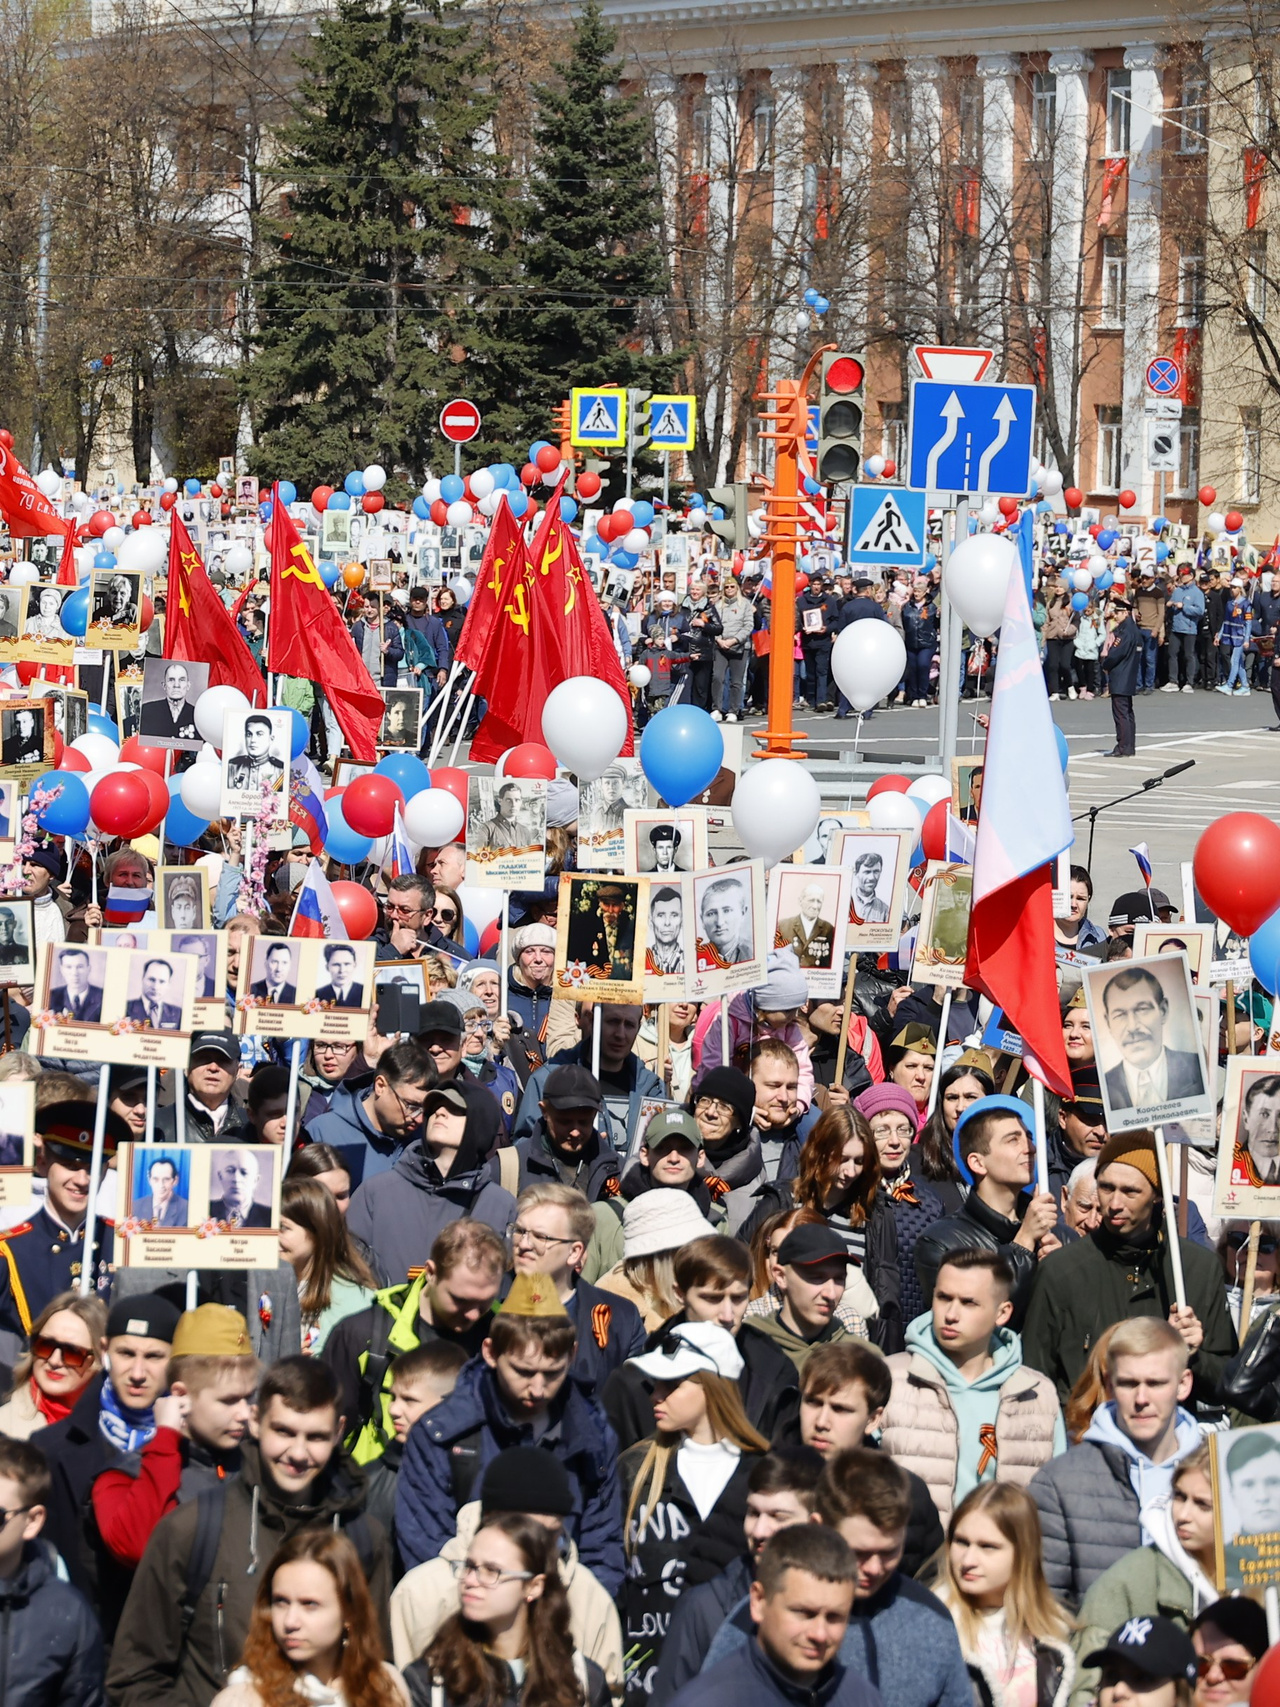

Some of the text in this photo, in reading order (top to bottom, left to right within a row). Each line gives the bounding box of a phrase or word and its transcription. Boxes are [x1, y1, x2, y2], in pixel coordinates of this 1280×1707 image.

[20, 491, 35, 510] 79
[1136, 1100, 1183, 1115] Коростелев
[1150, 1106, 1200, 1122] Николаевич
